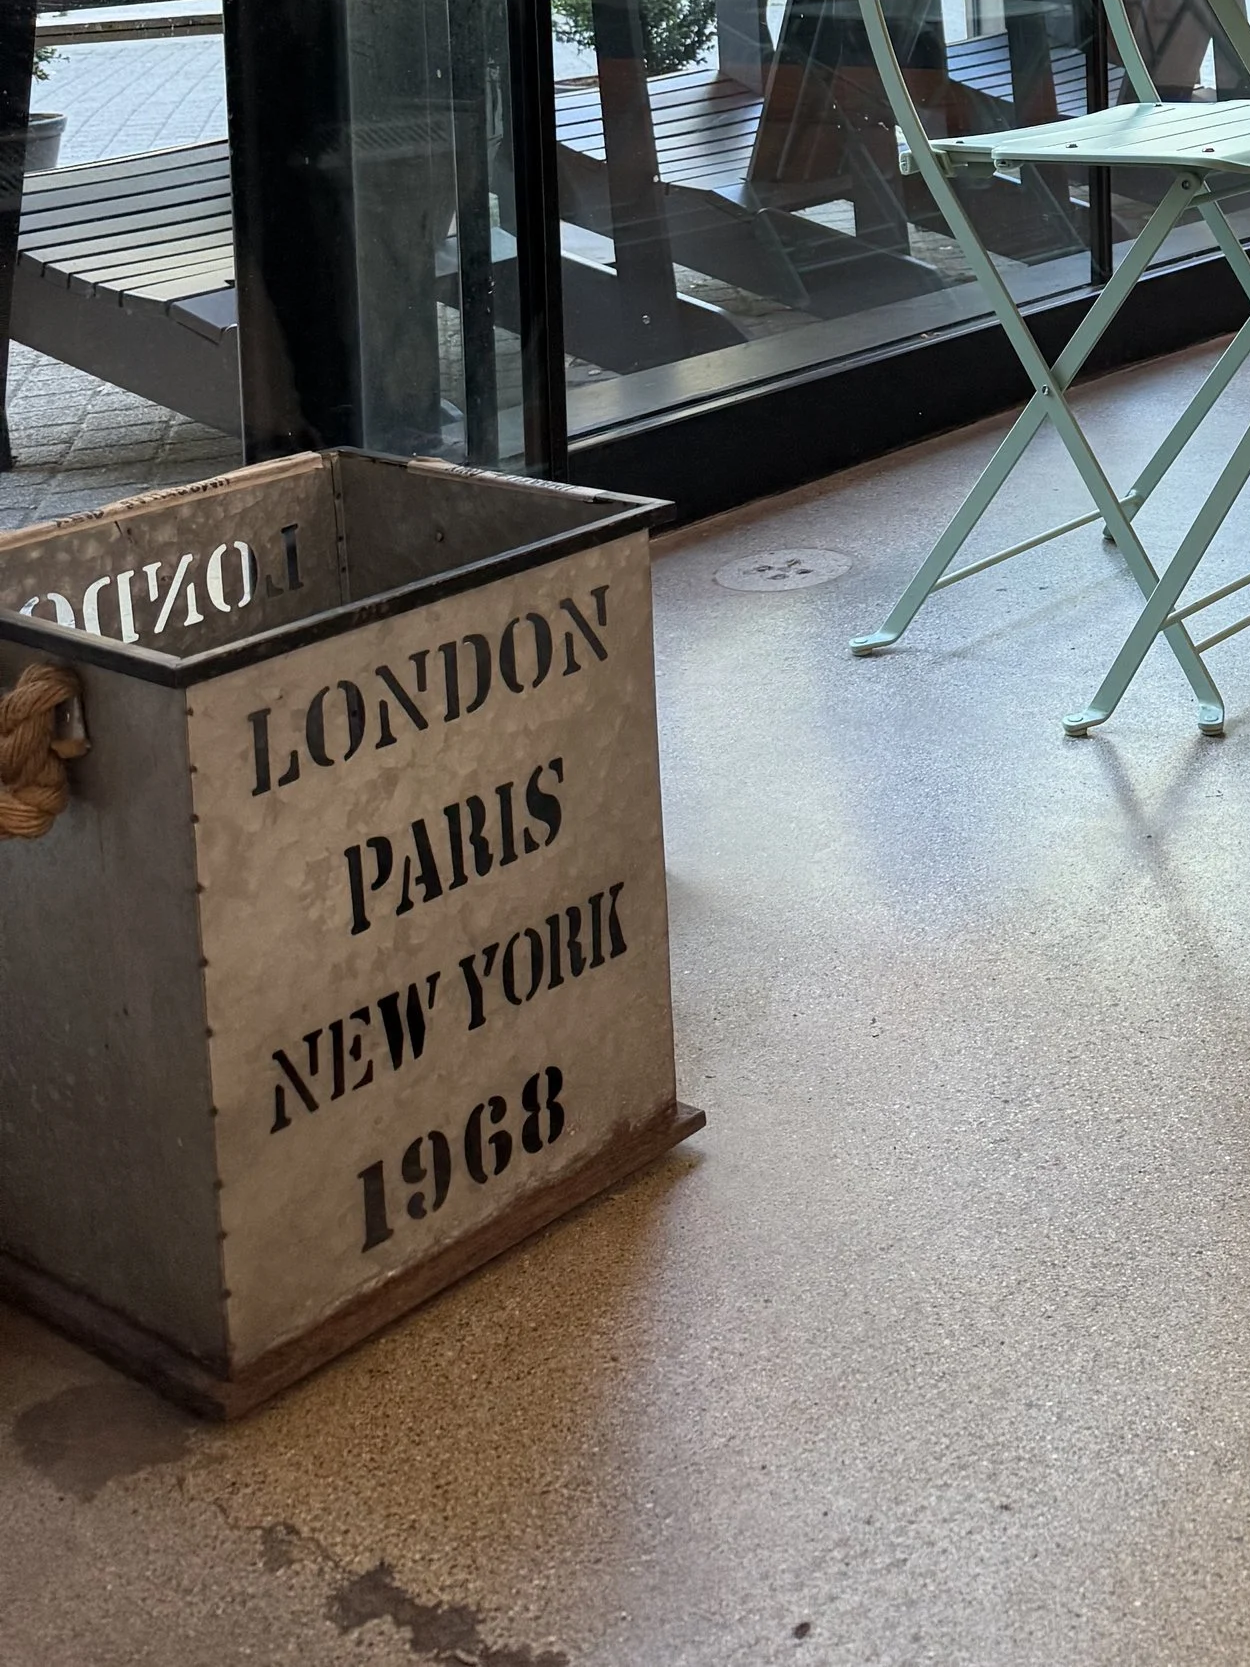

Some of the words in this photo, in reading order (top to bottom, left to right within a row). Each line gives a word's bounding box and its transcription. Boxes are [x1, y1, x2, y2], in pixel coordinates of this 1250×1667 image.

[247, 585, 610, 797] LONDON
[343, 757, 564, 936] PARIS
[269, 971, 441, 1135] NEW
[458, 881, 628, 1032] YORK
[357, 1065, 566, 1254] 1968
